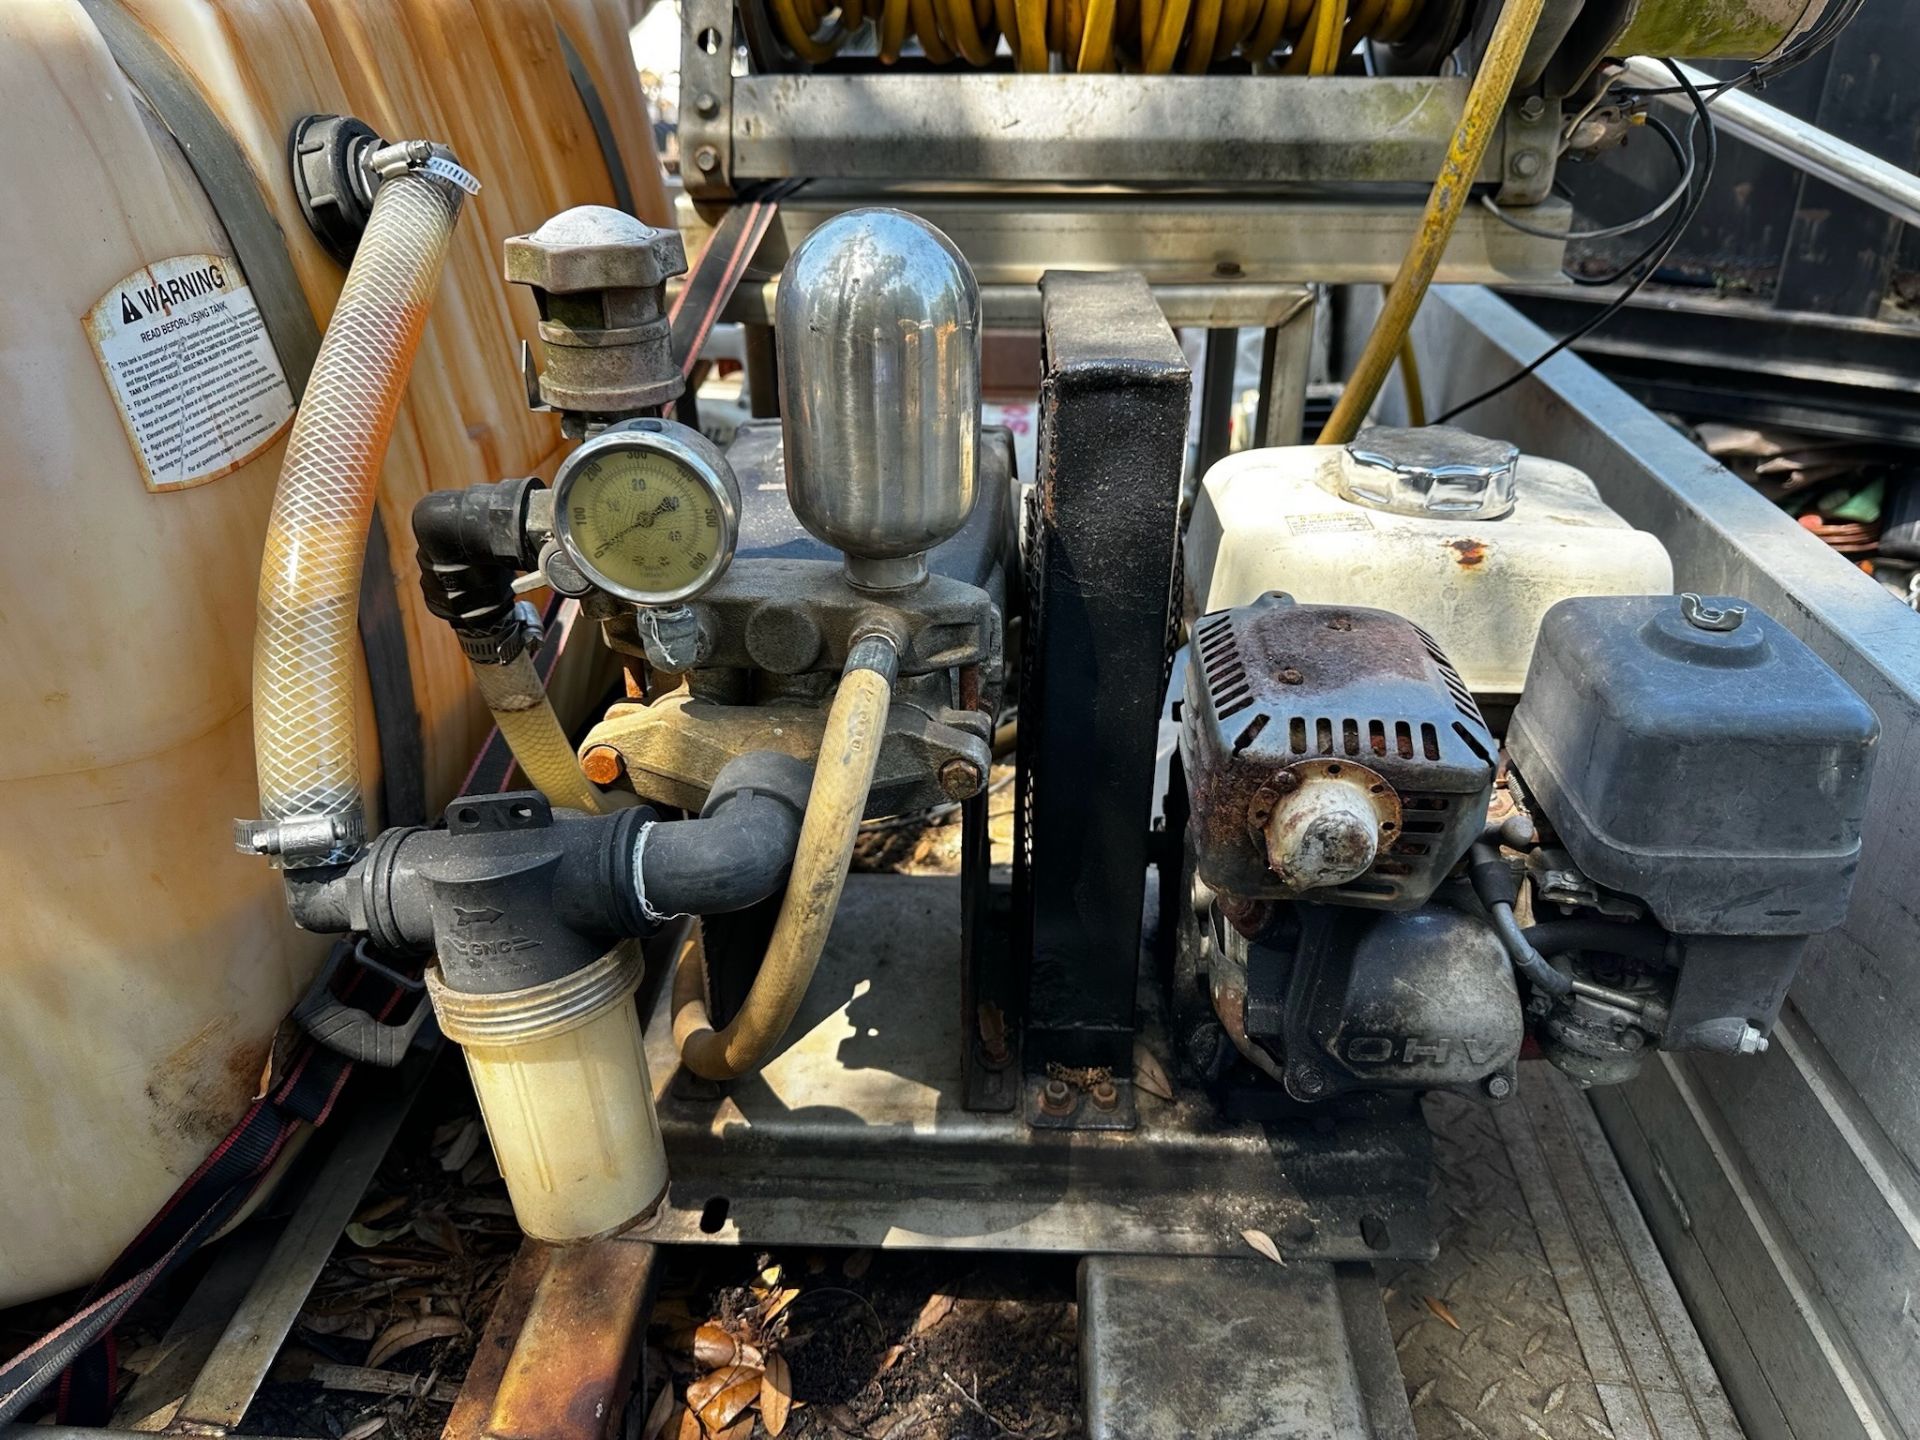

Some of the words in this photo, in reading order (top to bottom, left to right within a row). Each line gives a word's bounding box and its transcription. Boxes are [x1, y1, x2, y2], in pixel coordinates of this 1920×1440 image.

[137, 263, 225, 315] WARNING
[139, 326, 162, 343] READ
[209, 300, 228, 314] TANK
[626, 451, 648, 460] 300
[583, 462, 603, 482] 200
[573, 507, 587, 526] 100
[704, 508, 718, 528] 500
[688, 552, 708, 570] 600
[469, 939, 512, 956] GNC
[1348, 1037, 1504, 1064] OHV
